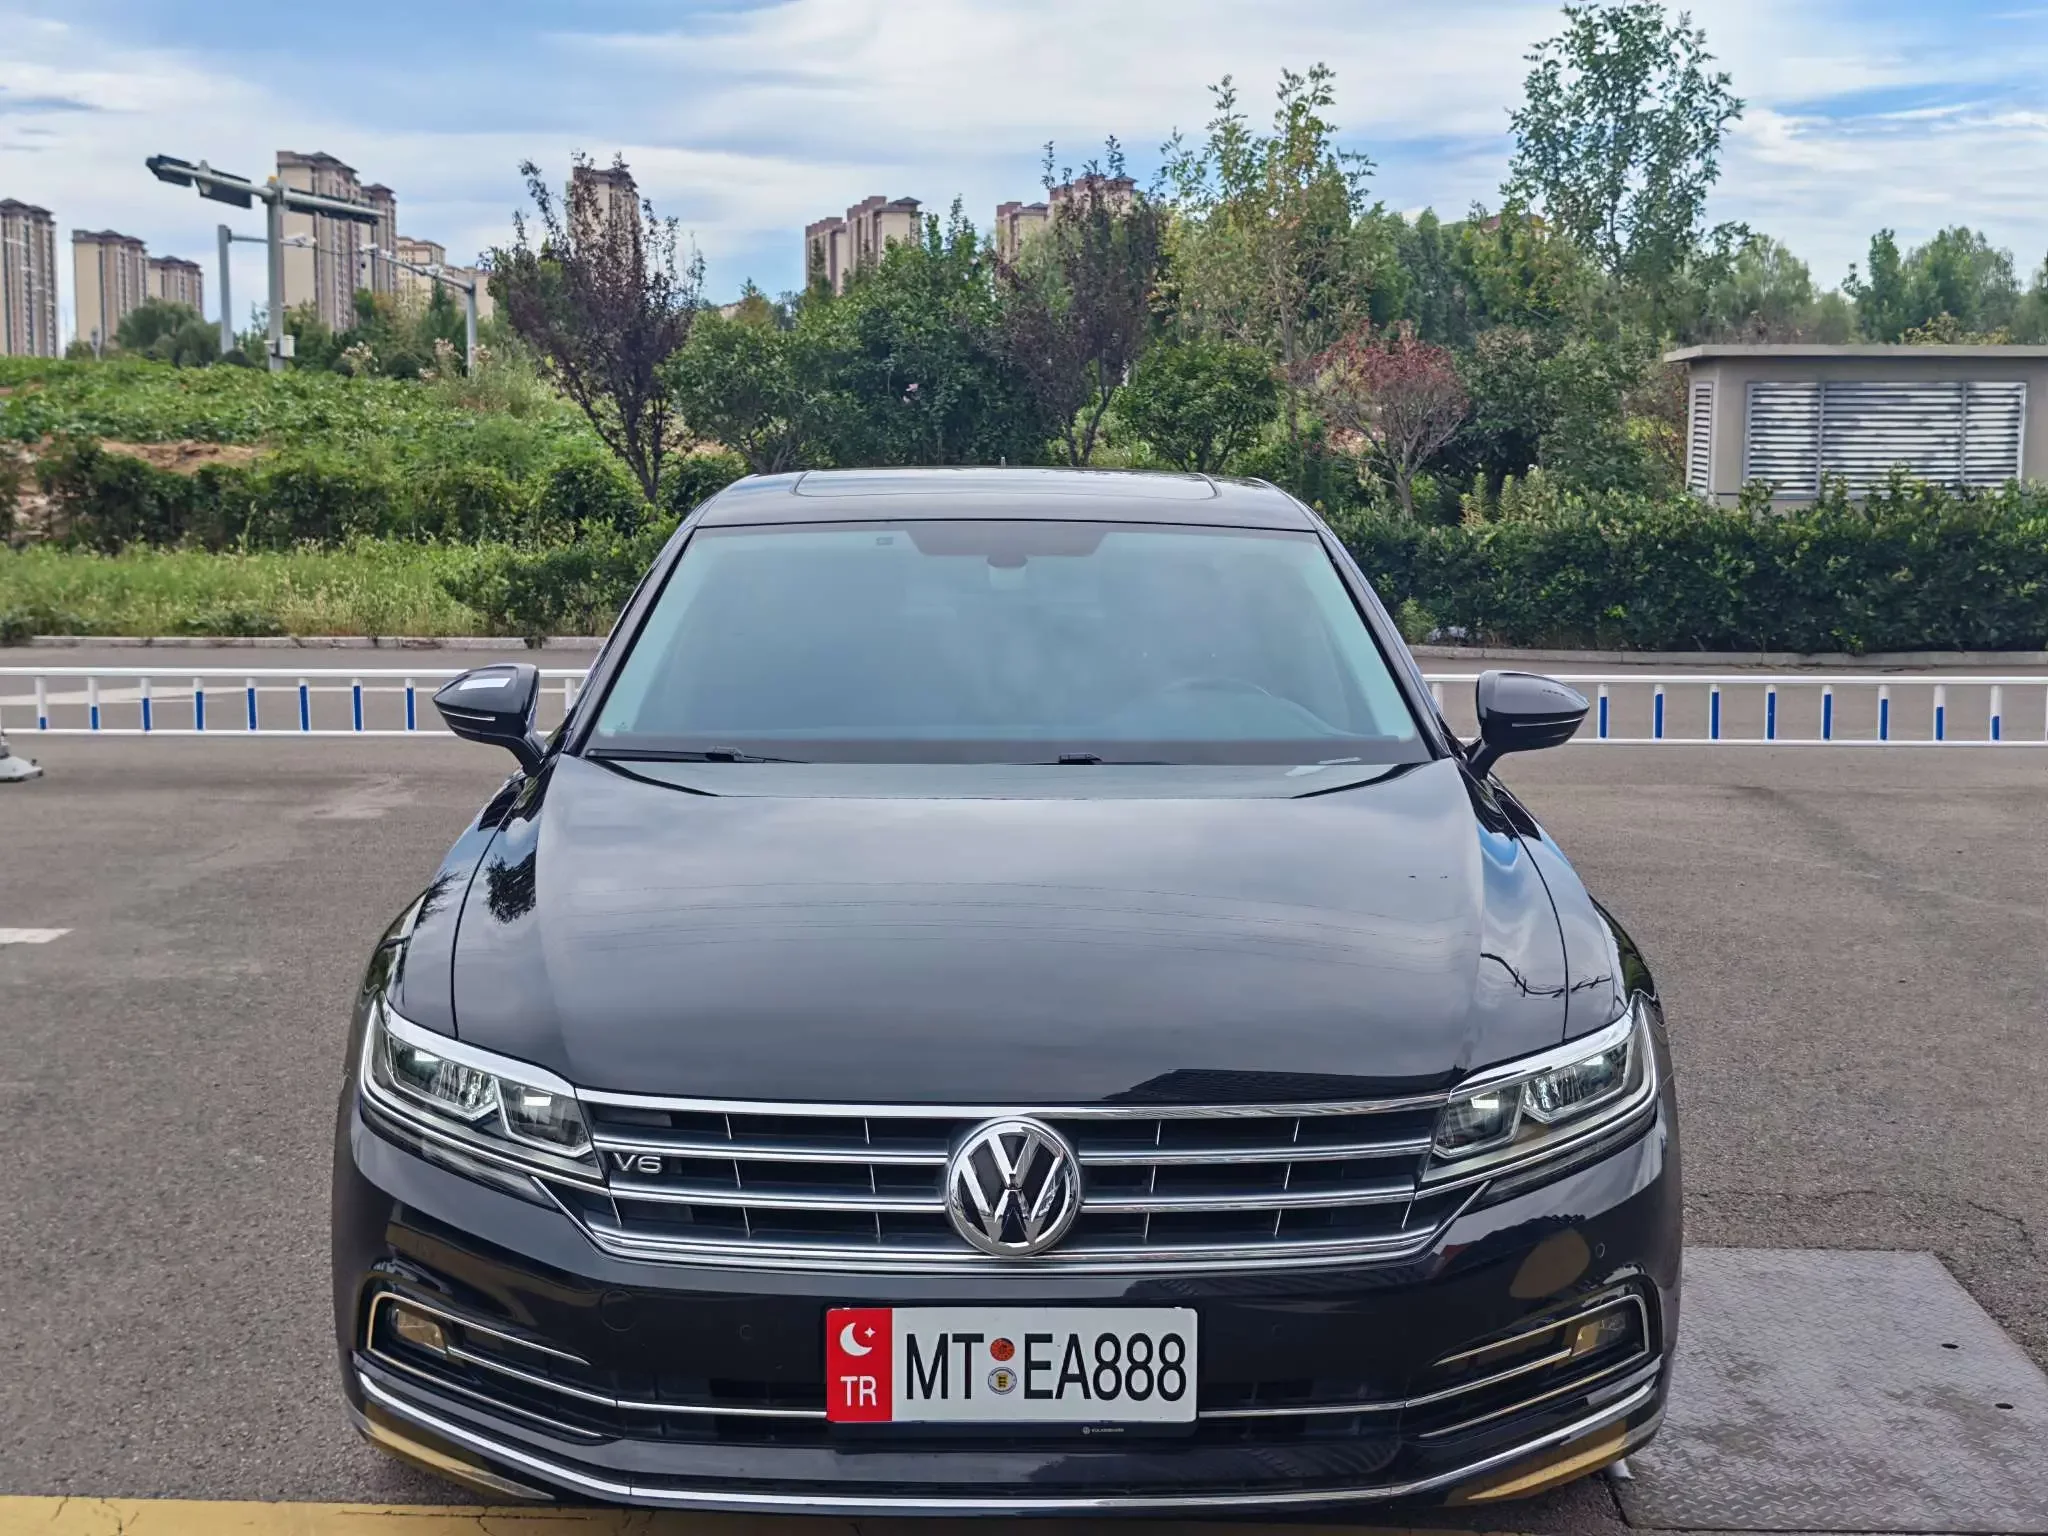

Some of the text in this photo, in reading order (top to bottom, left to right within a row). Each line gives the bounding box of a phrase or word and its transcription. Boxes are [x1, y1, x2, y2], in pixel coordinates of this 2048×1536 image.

[613, 1152, 662, 1174] V6
[907, 1333, 984, 1400] MT
[1024, 1332, 1187, 1402] EA888
[840, 1375, 877, 1407] TR
